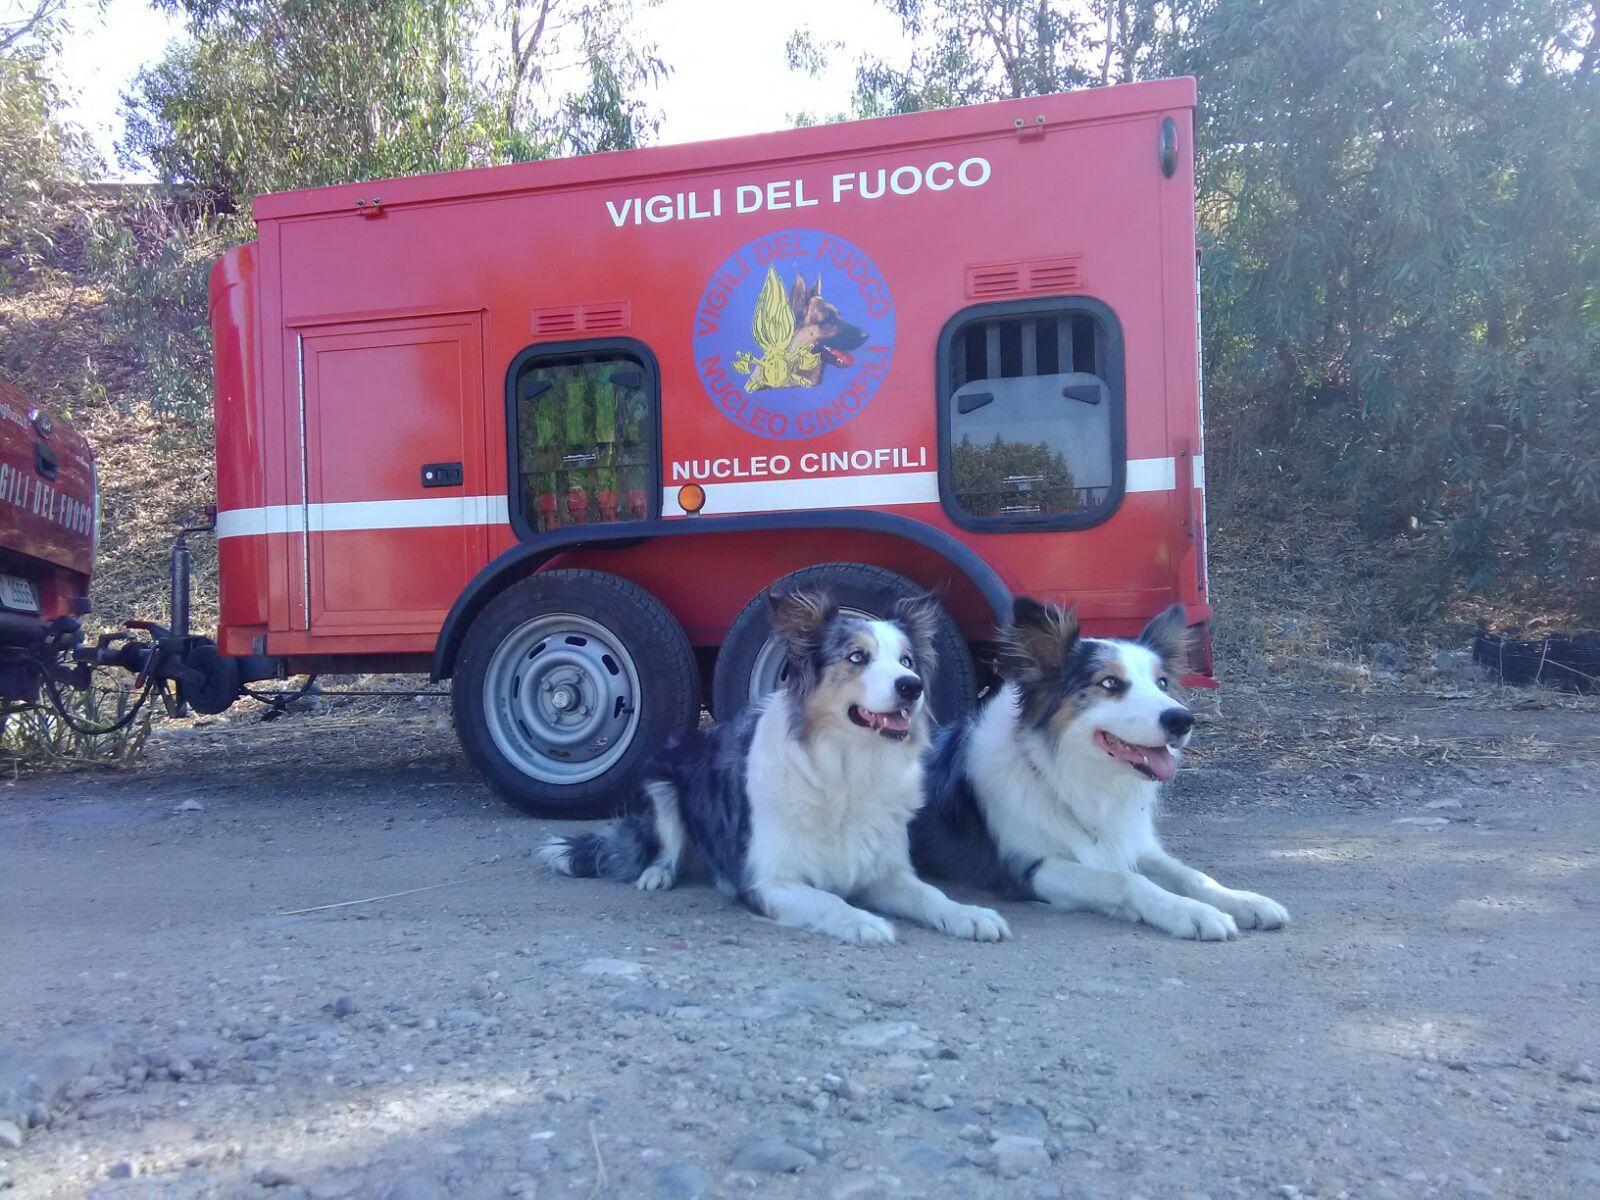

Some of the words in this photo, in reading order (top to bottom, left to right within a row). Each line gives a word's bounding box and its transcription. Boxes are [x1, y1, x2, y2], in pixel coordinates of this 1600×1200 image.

[606, 188, 721, 227] VIGILI
[736, 179, 818, 213] DEL
[832, 157, 991, 203] FUOCO
[697, 255, 751, 336] VIGILI
[754, 233, 810, 266] DEL
[815, 236, 891, 319] FUOCO
[701, 354, 788, 436] NUCLEO
[797, 345, 890, 435] CINOFILI
[672, 454, 791, 480] NUCLEO
[799, 446, 927, 473] CINOFILI
[33, 479, 56, 521] DEL
[59, 493, 92, 536] FUOCO
